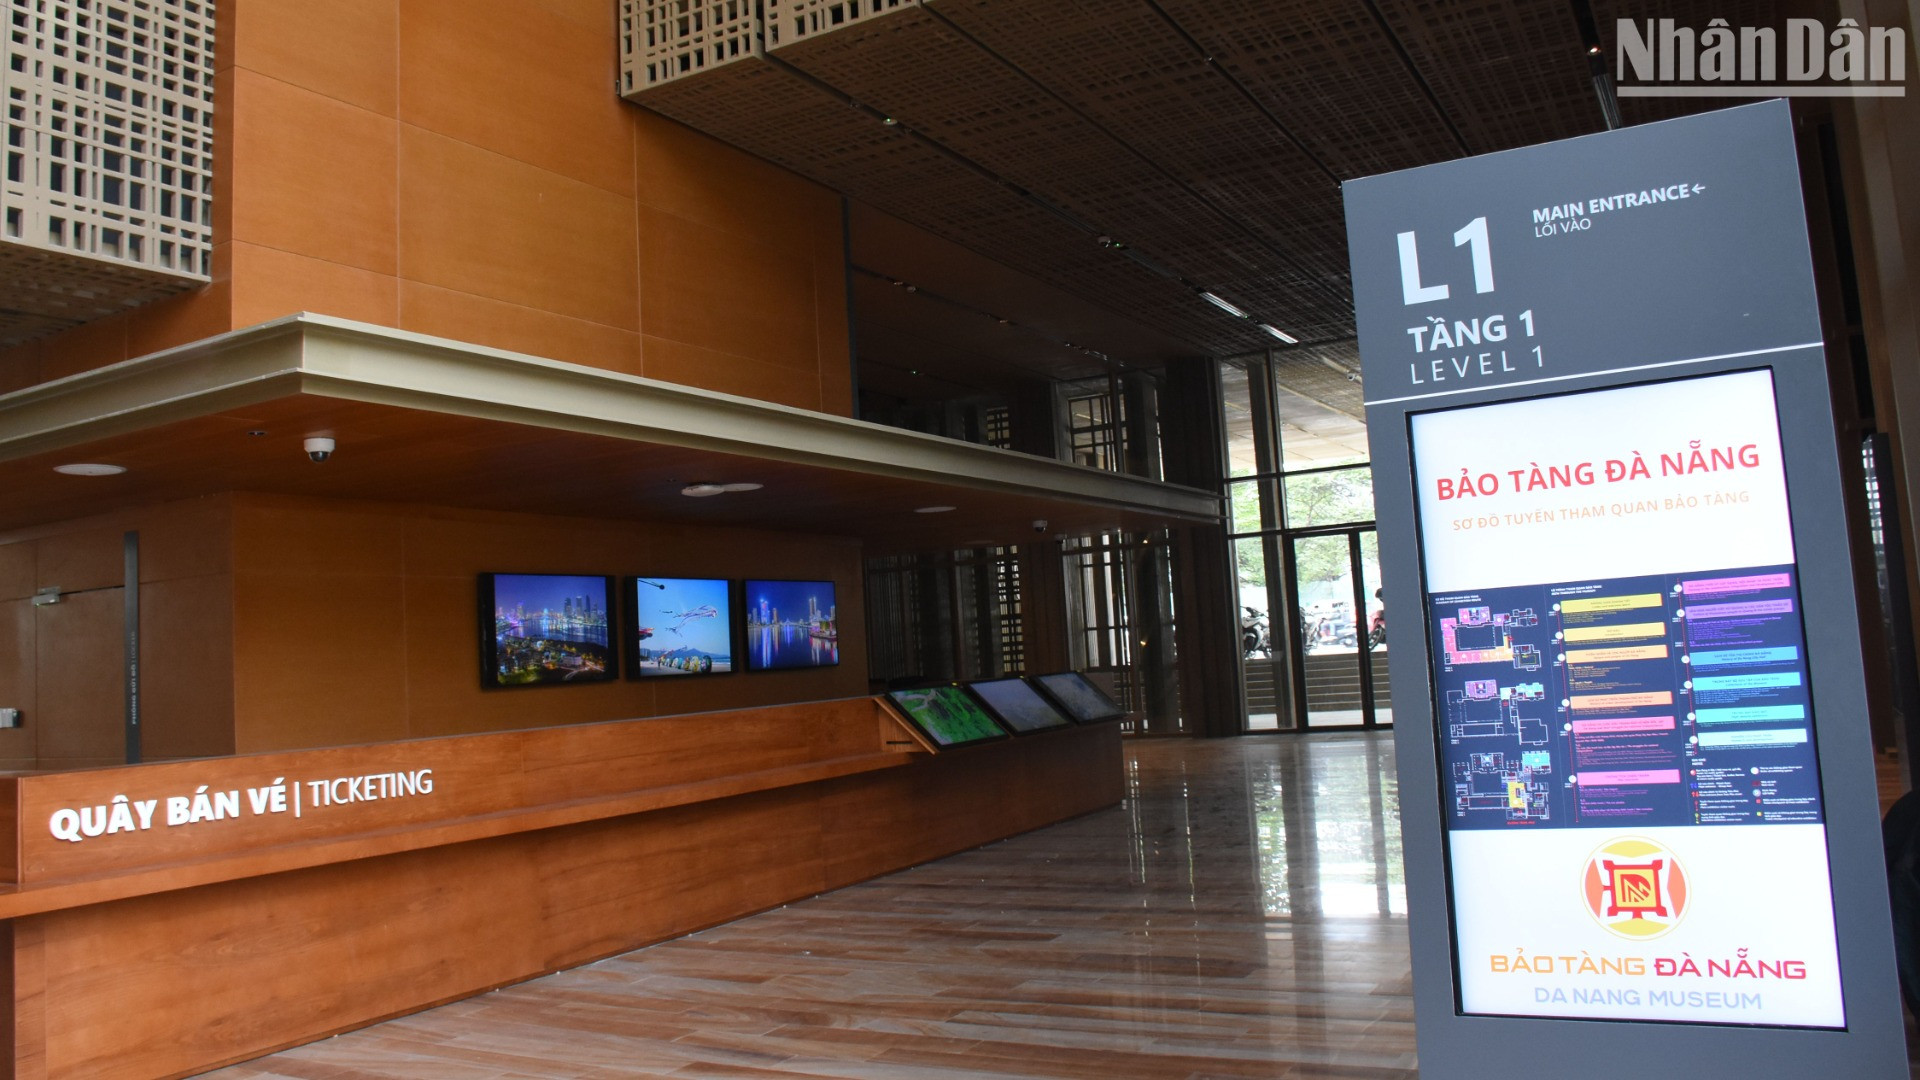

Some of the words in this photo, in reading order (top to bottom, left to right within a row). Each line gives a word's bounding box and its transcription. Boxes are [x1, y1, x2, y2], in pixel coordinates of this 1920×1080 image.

[1532, 202, 1584, 224] MAIN
[1589, 183, 1690, 214] ENTRANCE
[1560, 217, 1592, 234] VÀO
[1397, 217, 1495, 306] L1
[1406, 315, 1508, 353] TẦNG
[1519, 309, 1536, 337] 1
[1410, 351, 1516, 384] LEVEL
[1531, 345, 1544, 368] 1
[1437, 467, 1500, 501] BẢO
[1508, 461, 1595, 493] TÀNG
[1604, 450, 1652, 483] ĐÀ
[1660, 439, 1761, 477] NẴNG
[1453, 516, 1475, 531] SƠ
[1477, 511, 1501, 529] ĐỒ
[1504, 507, 1556, 526] TUYẾN
[1559, 503, 1606, 521] THAM
[1611, 499, 1659, 518] QUAN
[1664, 493, 1699, 511] BẢO
[1705, 488, 1751, 506] TÀNG
[49, 795, 158, 843] QUÂY
[166, 785, 240, 826] BÁN
[248, 777, 288, 815] VÉ
[307, 769, 434, 808] TICKETING
[1490, 947, 1554, 974] BẢO
[1558, 950, 1646, 976] TÀNG
[1653, 951, 1704, 978] ĐÀ
[1708, 947, 1808, 980] NẴNG
[1534, 987, 1569, 1004] DA
[1572, 987, 1642, 1007] NANG
[1648, 990, 1764, 1010] MUSEUM
